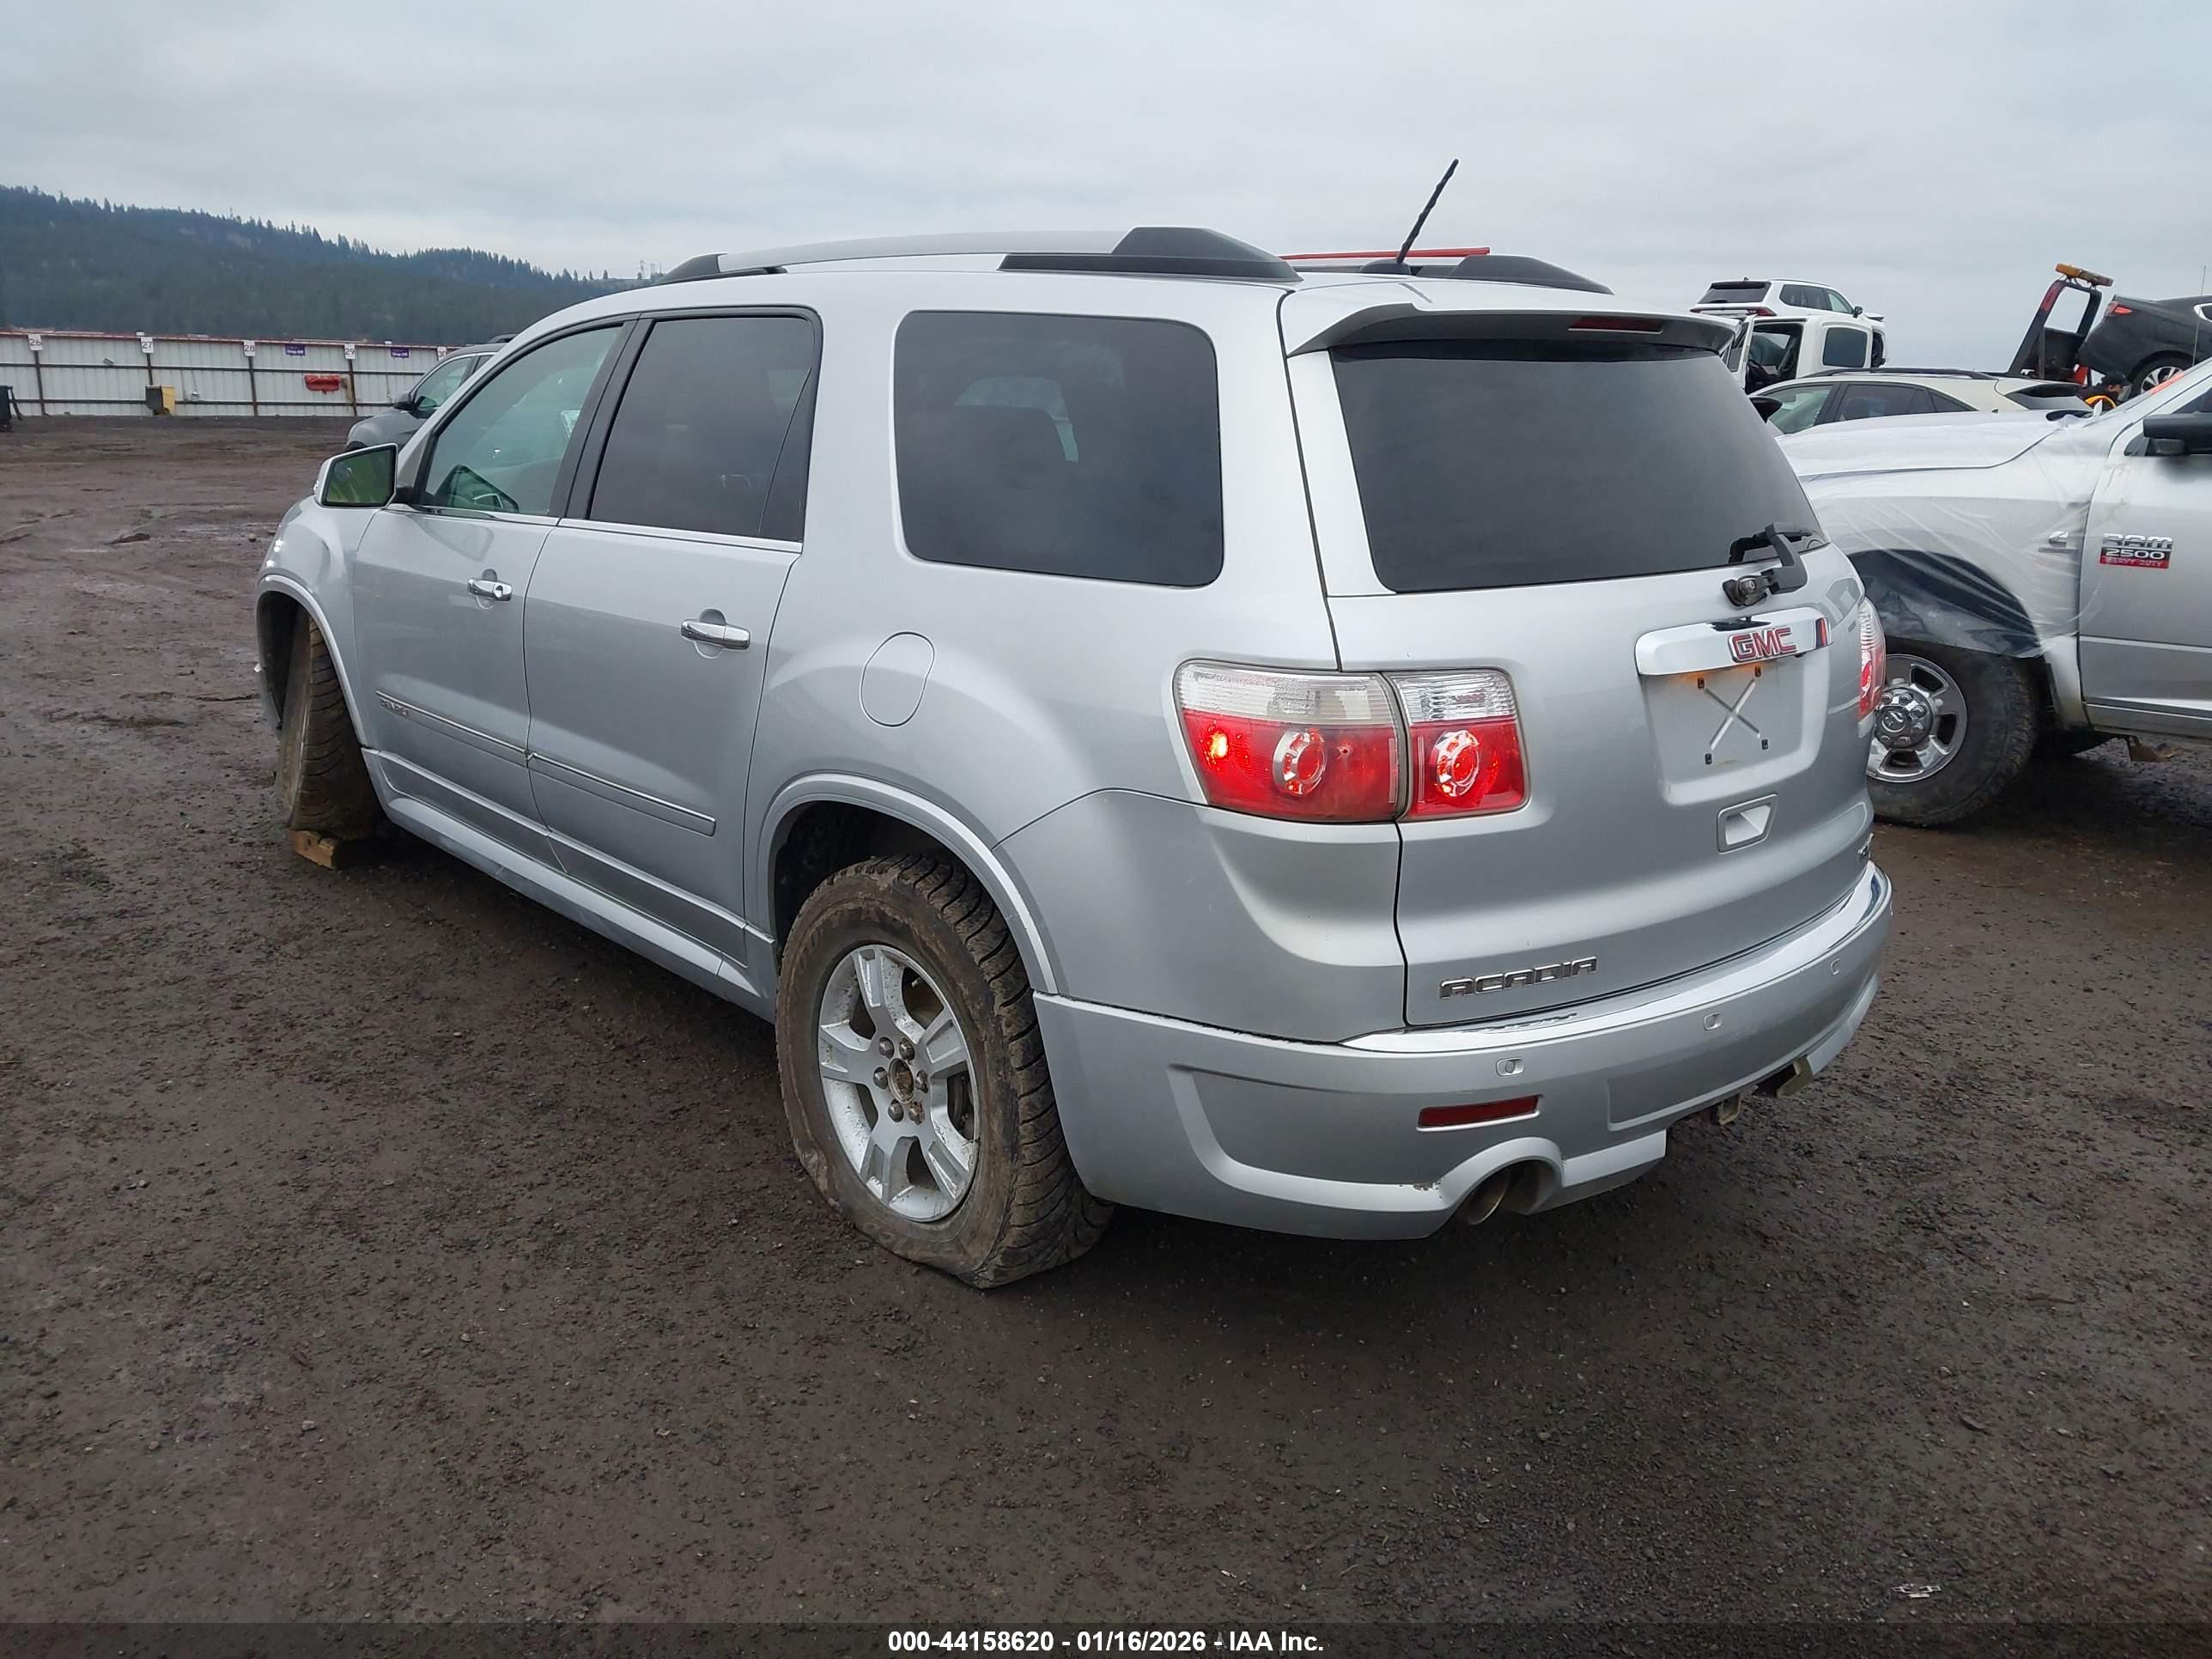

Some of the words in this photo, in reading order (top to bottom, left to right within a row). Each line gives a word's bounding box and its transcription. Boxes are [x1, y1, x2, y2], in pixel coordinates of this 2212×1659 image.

[142, 341, 153, 349] 27
[2101, 532, 2173, 550] RAM
[2106, 548, 2165, 560] 2500
[1729, 626, 1798, 662] GMC
[1439, 956, 1598, 1000] ACADIA
